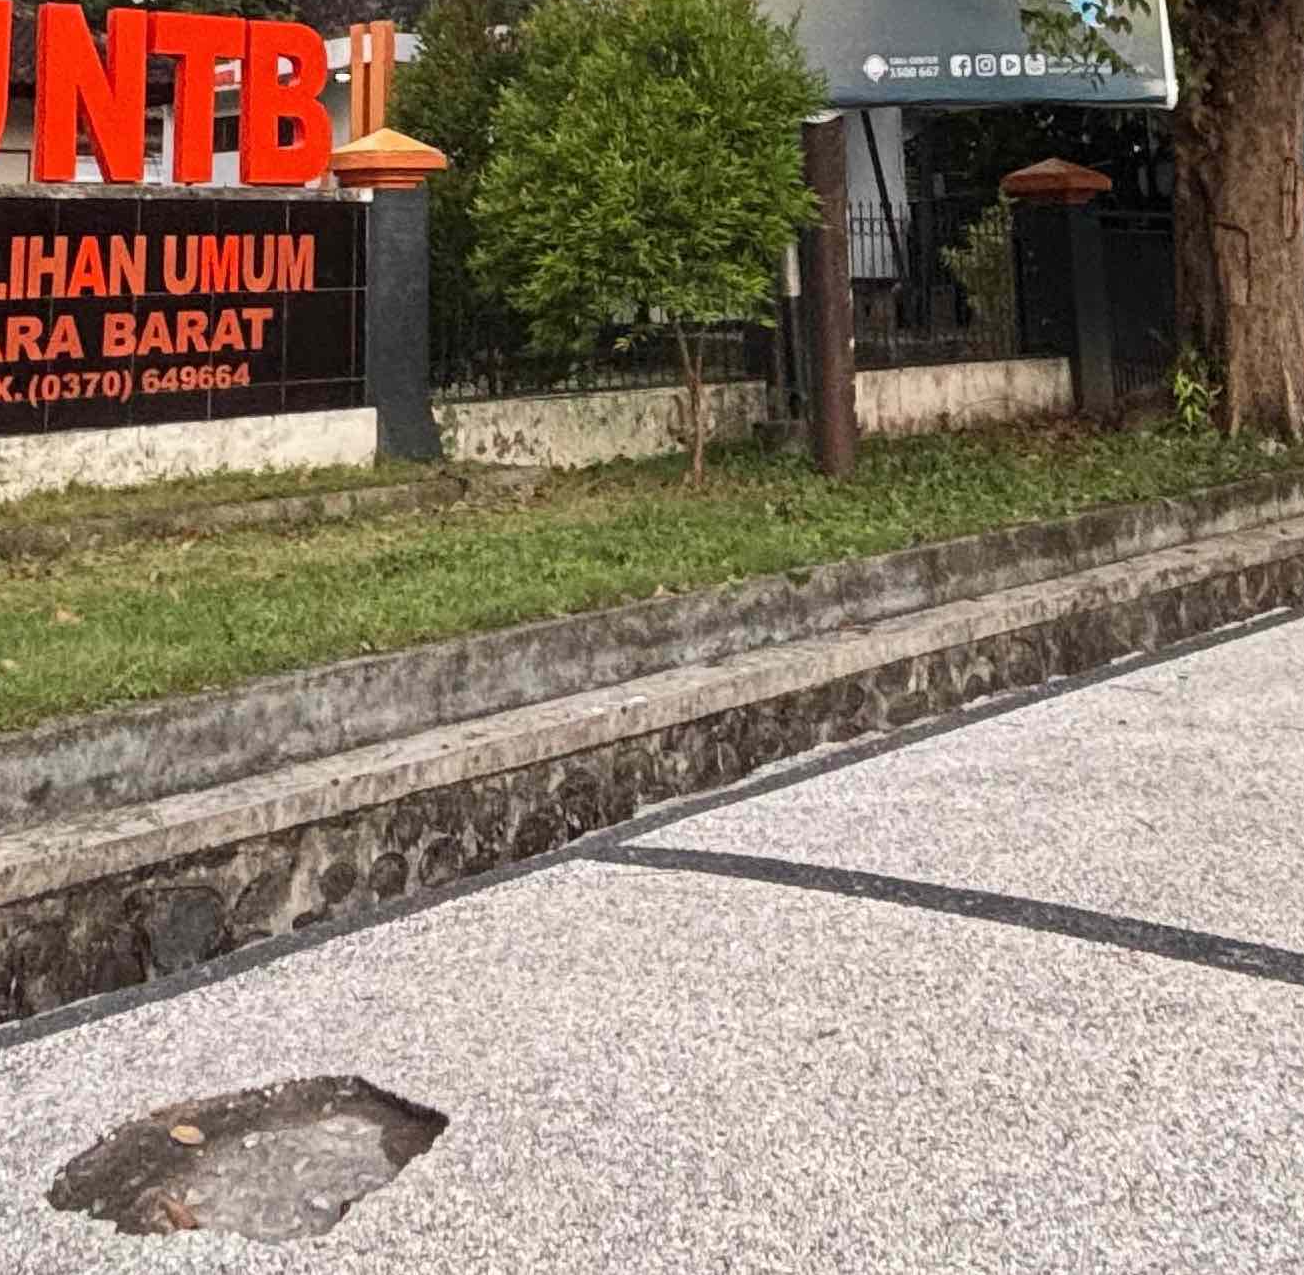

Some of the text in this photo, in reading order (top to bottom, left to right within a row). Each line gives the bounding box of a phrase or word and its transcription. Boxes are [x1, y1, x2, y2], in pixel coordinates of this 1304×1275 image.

[34, 2, 333, 186] NTB
[163, 233, 316, 294] UMUM
[102, 307, 274, 358] BARAT
[141, 362, 252, 395] 649664
